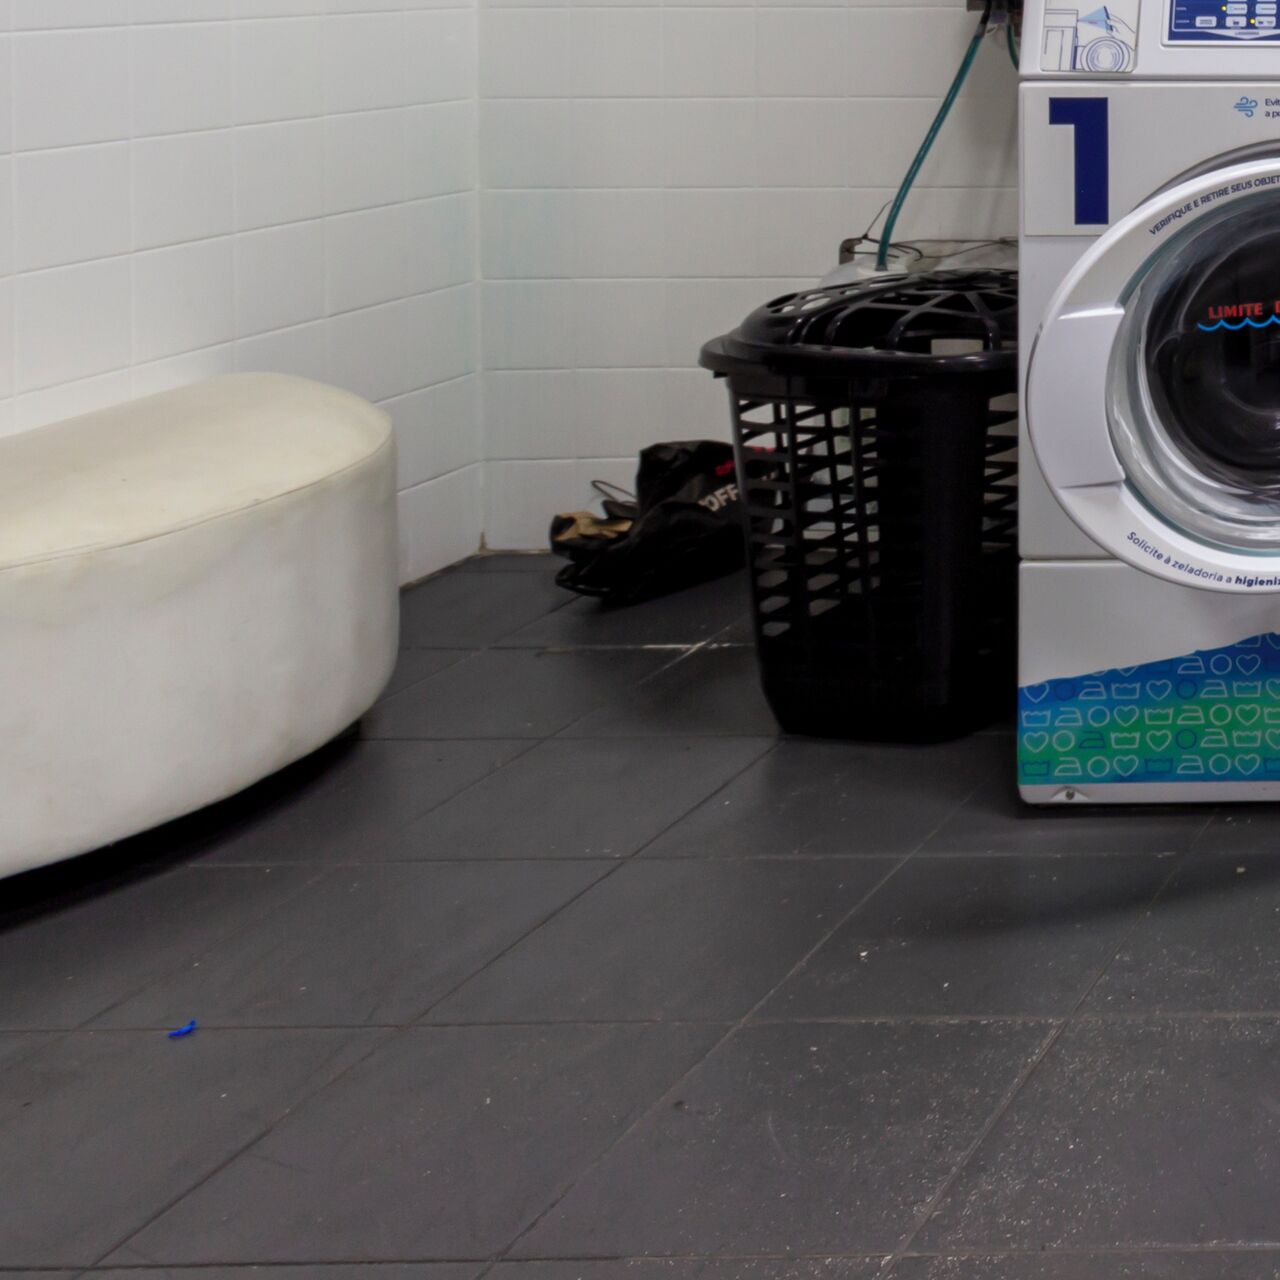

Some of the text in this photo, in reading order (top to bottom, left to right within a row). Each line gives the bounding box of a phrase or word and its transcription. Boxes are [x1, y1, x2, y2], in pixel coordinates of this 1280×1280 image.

[1265, 110, 1270, 118] a
[1049, 97, 1108, 225] 1
[1149, 204, 1192, 235] VERIFIQUE
[1194, 200, 1200, 208] E
[1200, 186, 1230, 204] RETIRE
[1231, 181, 1253, 194] SEUS
[1208, 302, 1263, 319] LIMITE
[1126, 532, 1163, 560] Solicite
[1172, 560, 1223, 584] zeladoria
